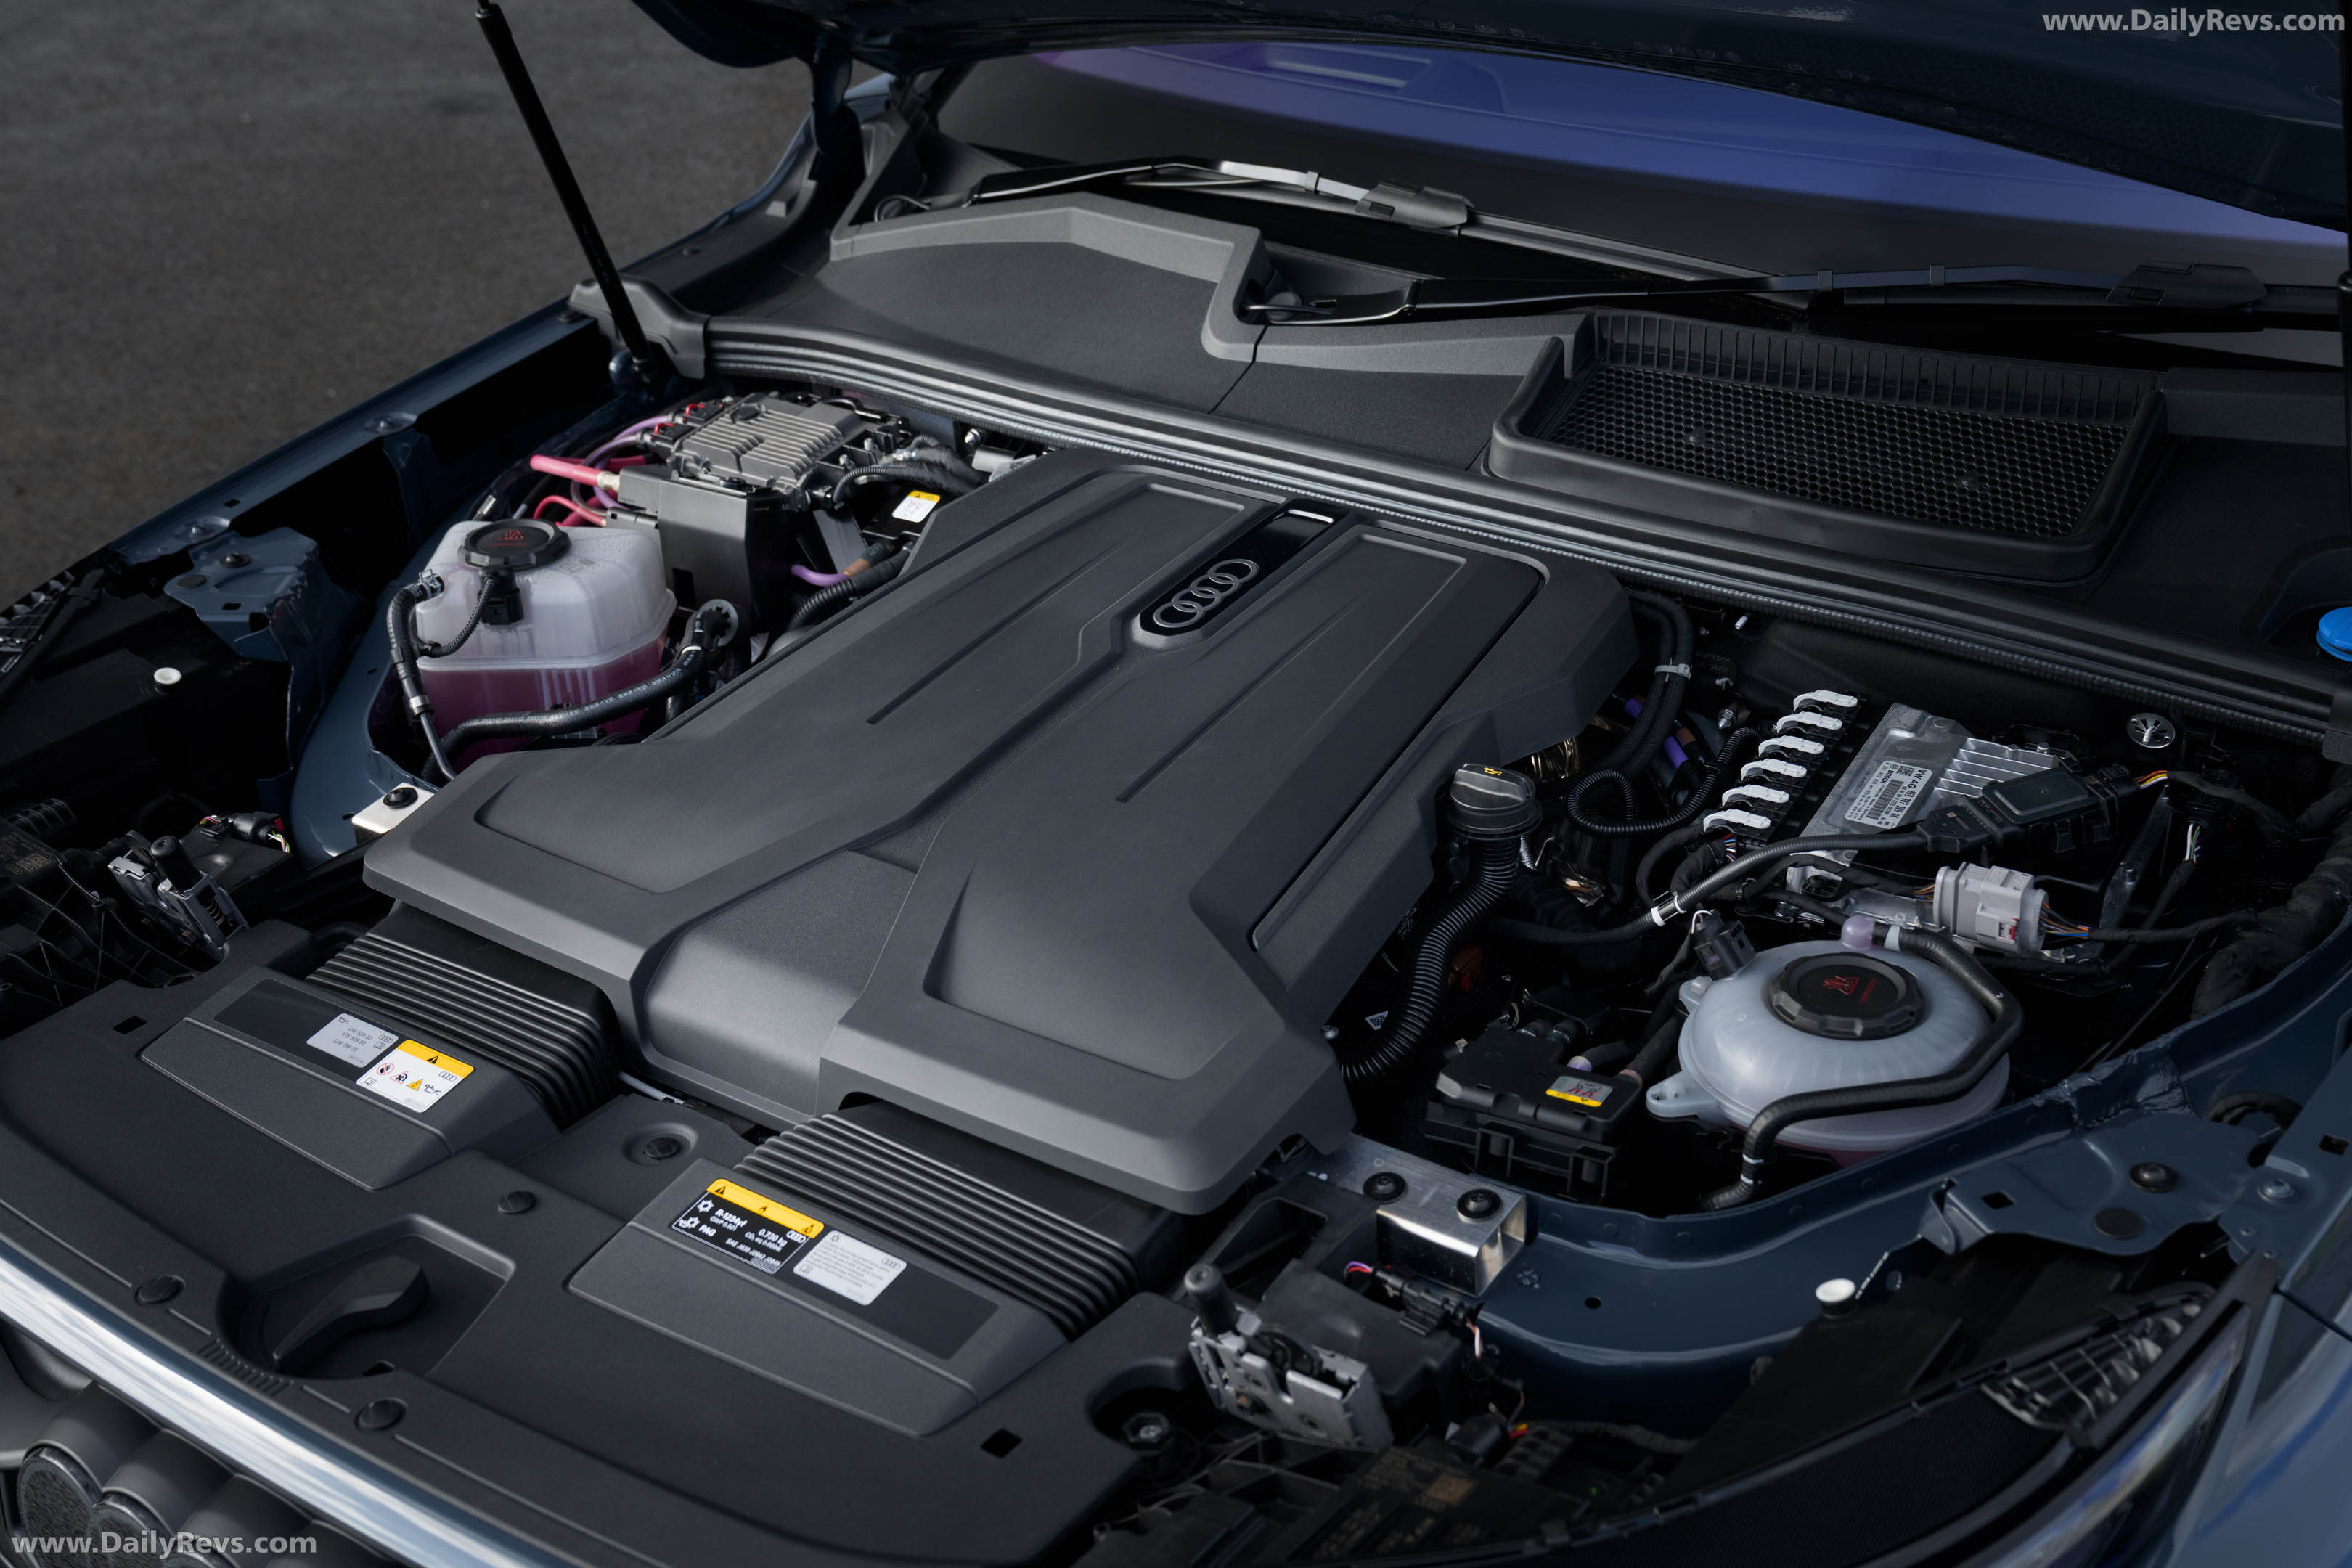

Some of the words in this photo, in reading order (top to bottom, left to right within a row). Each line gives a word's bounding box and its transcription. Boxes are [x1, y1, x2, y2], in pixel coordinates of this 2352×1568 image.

[1880, 769, 1894, 784] BOSCH
[1914, 769, 1927, 780] VW
[1908, 779, 1919, 788] AG
[714, 1209, 748, 1228] R-1234yf
[698, 1224, 717, 1237] PAG
